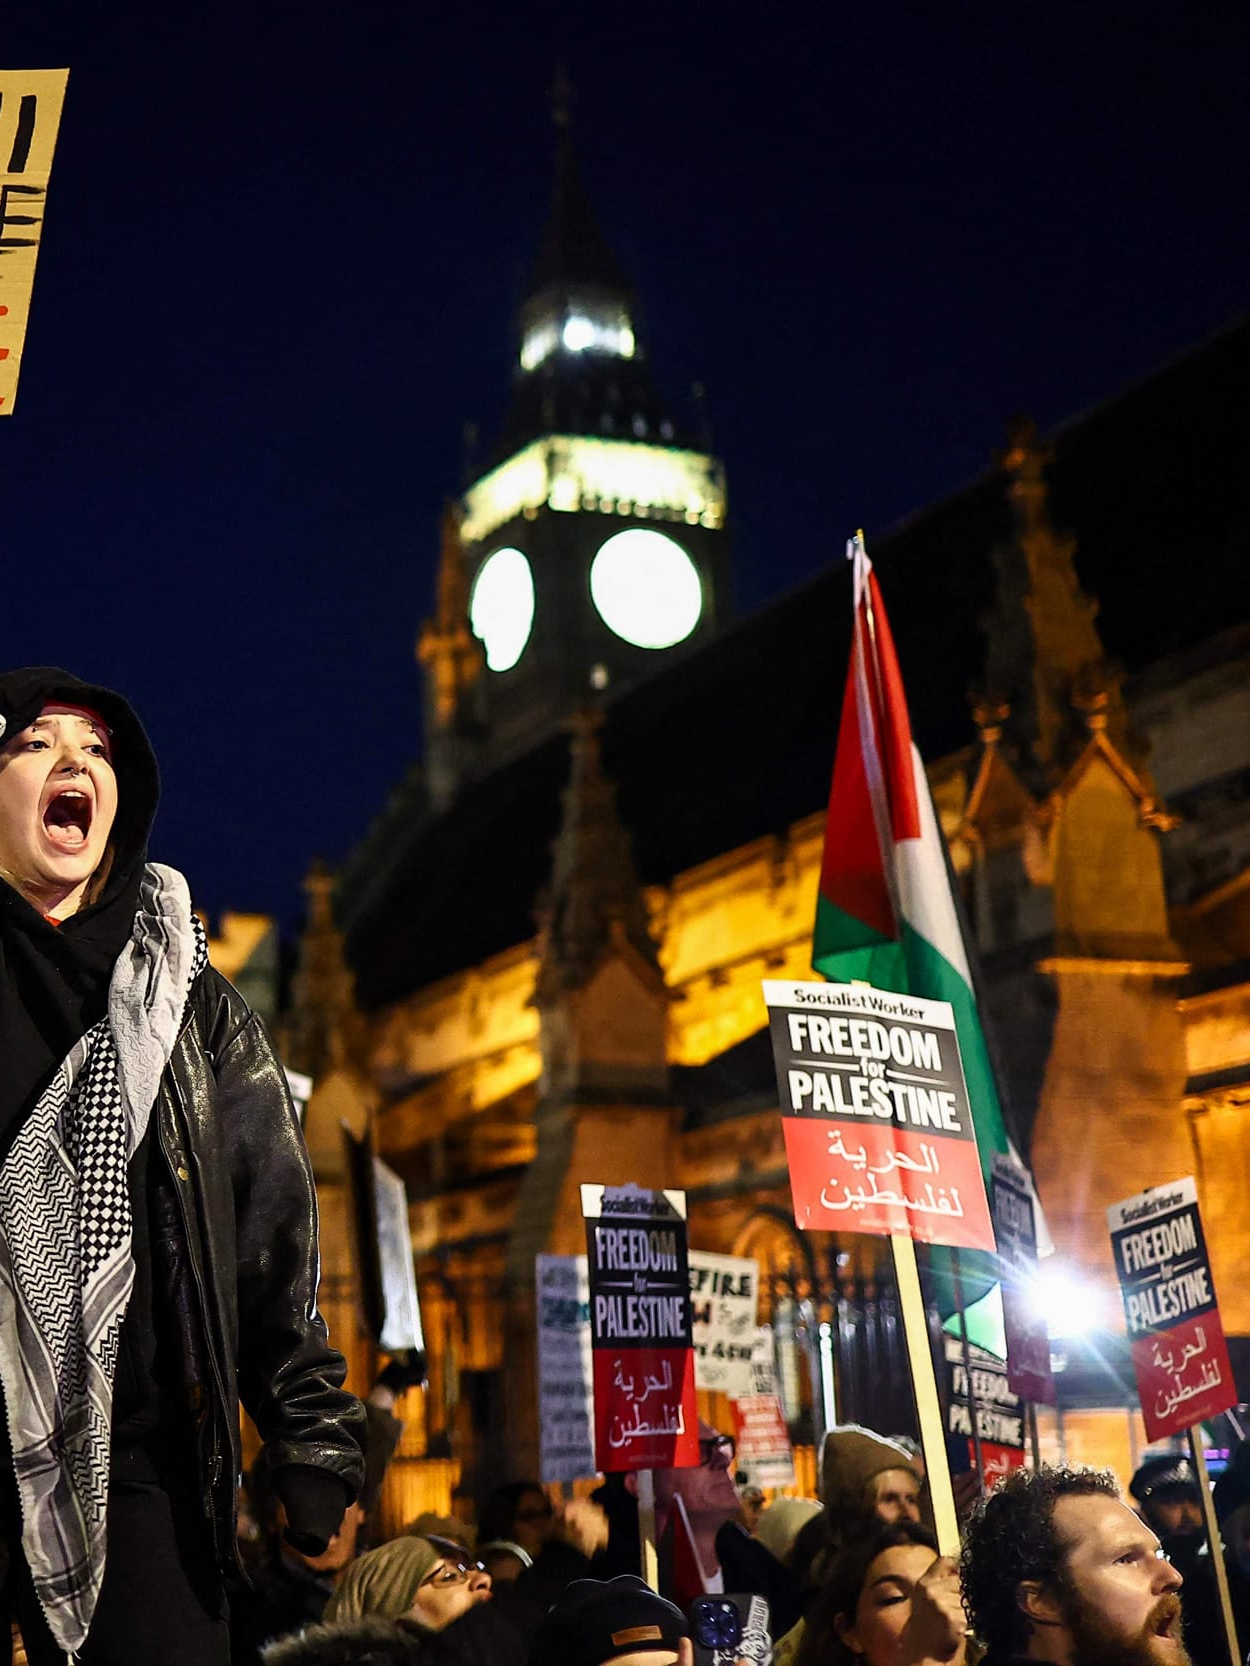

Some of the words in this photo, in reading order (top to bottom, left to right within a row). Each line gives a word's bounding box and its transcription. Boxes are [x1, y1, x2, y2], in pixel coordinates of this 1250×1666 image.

[794, 988, 867, 1009] Socialist
[870, 997, 926, 1020] Worker
[787, 1012, 943, 1073] FREEDOM
[859, 1056, 886, 1078] for
[787, 1069, 962, 1132] PALESTINE
[827, 1129, 940, 1175] الحرية
[819, 1171, 964, 1218] لفلسطين
[595, 1226, 678, 1272] FREEDOM
[1120, 1213, 1198, 1275] FREEDOM
[595, 1296, 686, 1338] PALESTINE
[1129, 1266, 1212, 1331] PALESTINE
[1153, 1326, 1208, 1374] الحرية
[613, 1359, 672, 1402] الحرية
[1154, 1358, 1223, 1419] لفلسطين
[609, 1401, 685, 1448] لفلسطين
[949, 1403, 1023, 1447] PAESTINE
